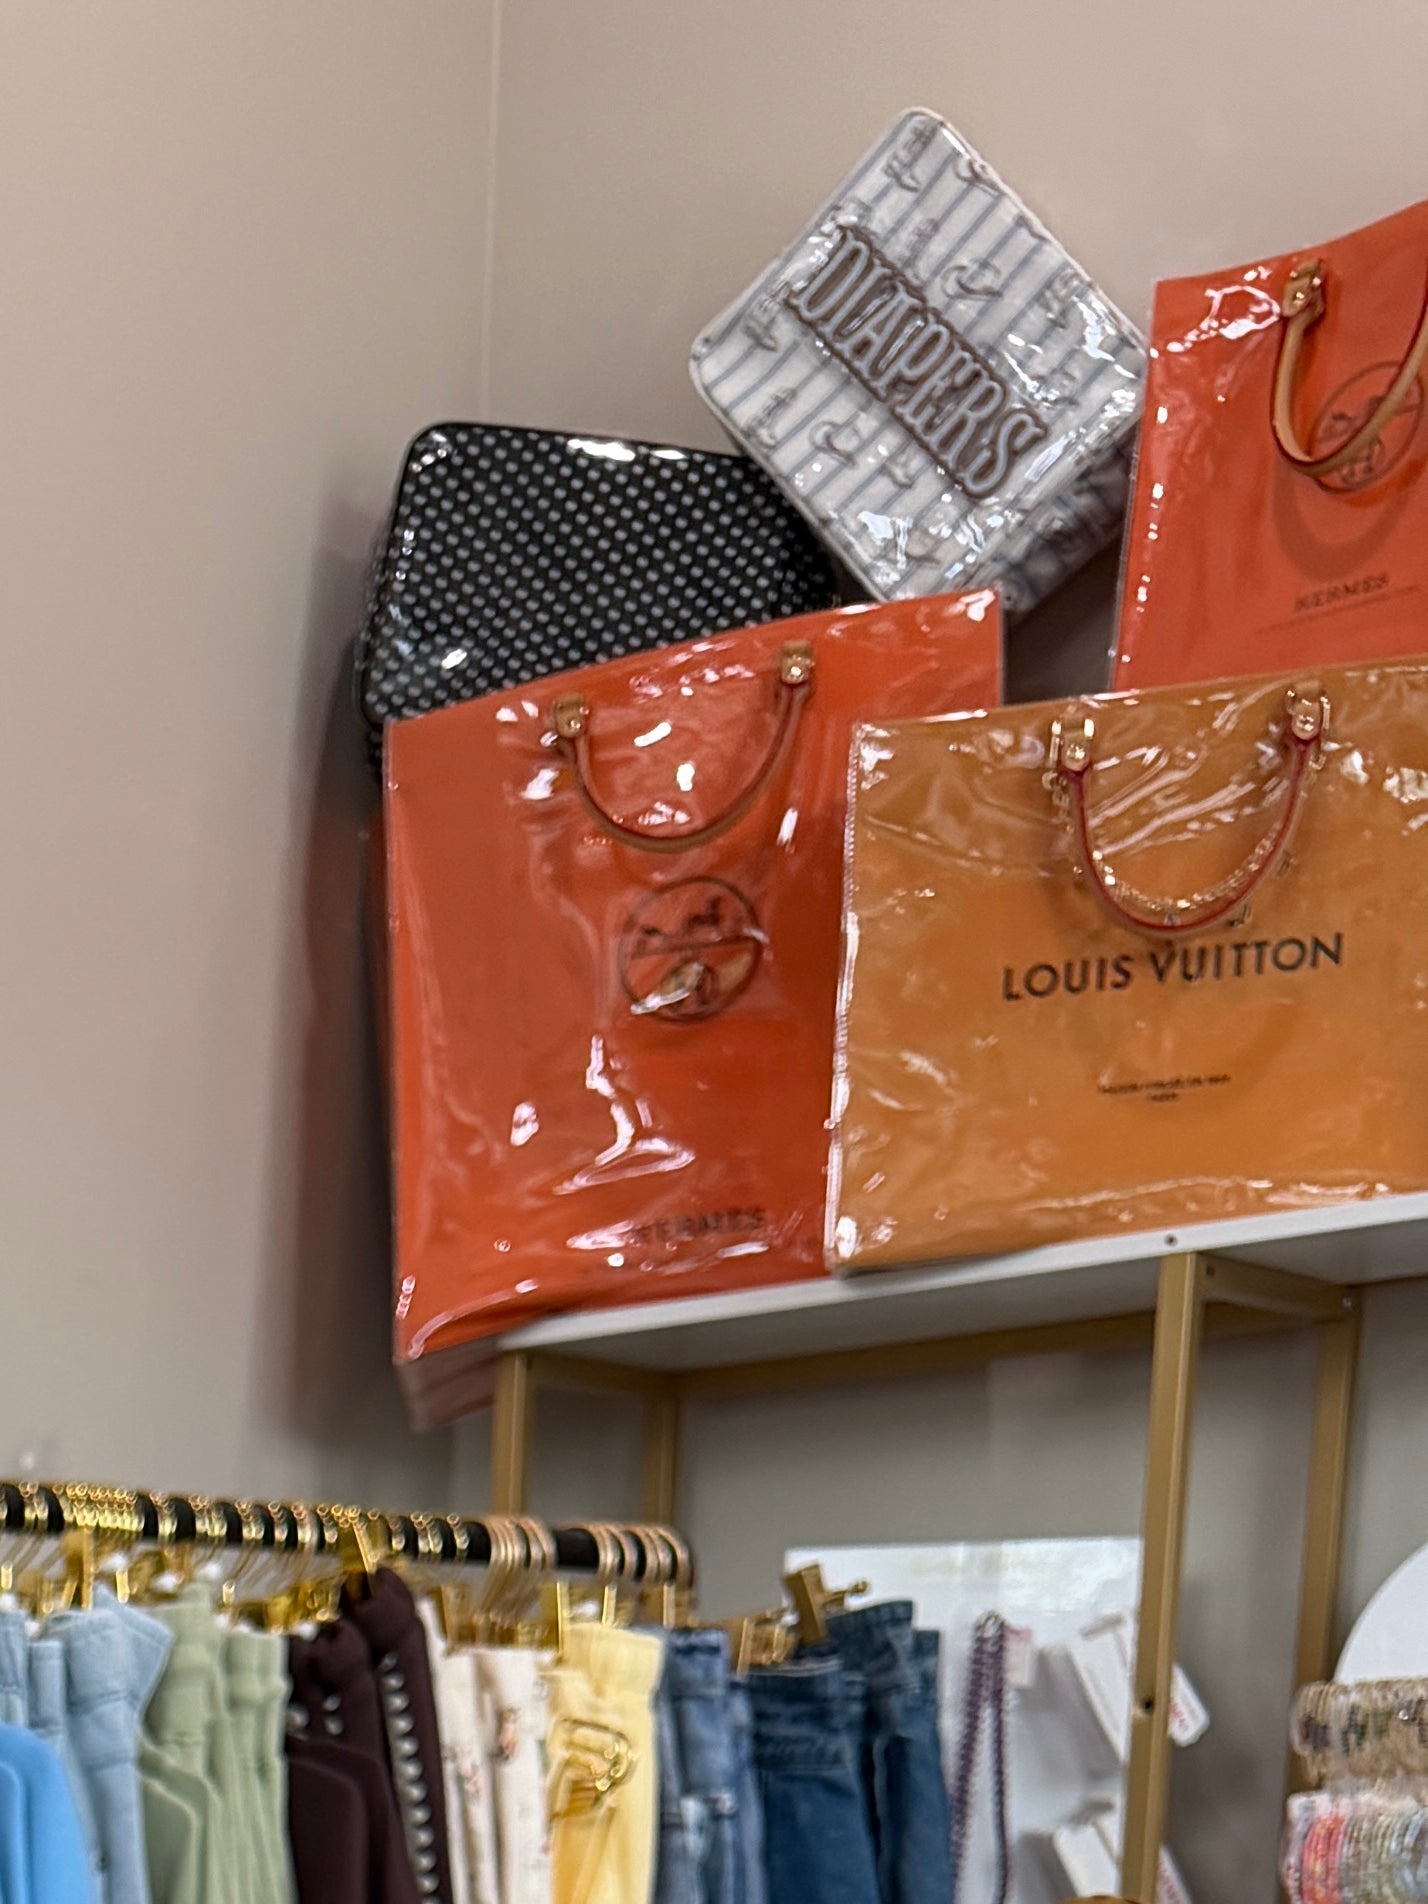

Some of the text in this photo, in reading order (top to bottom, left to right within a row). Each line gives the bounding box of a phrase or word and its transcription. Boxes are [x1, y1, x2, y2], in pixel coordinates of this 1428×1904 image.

[787, 226, 1047, 499] DIAPERS
[1001, 931, 1343, 1001] LOUIS VUITTON
